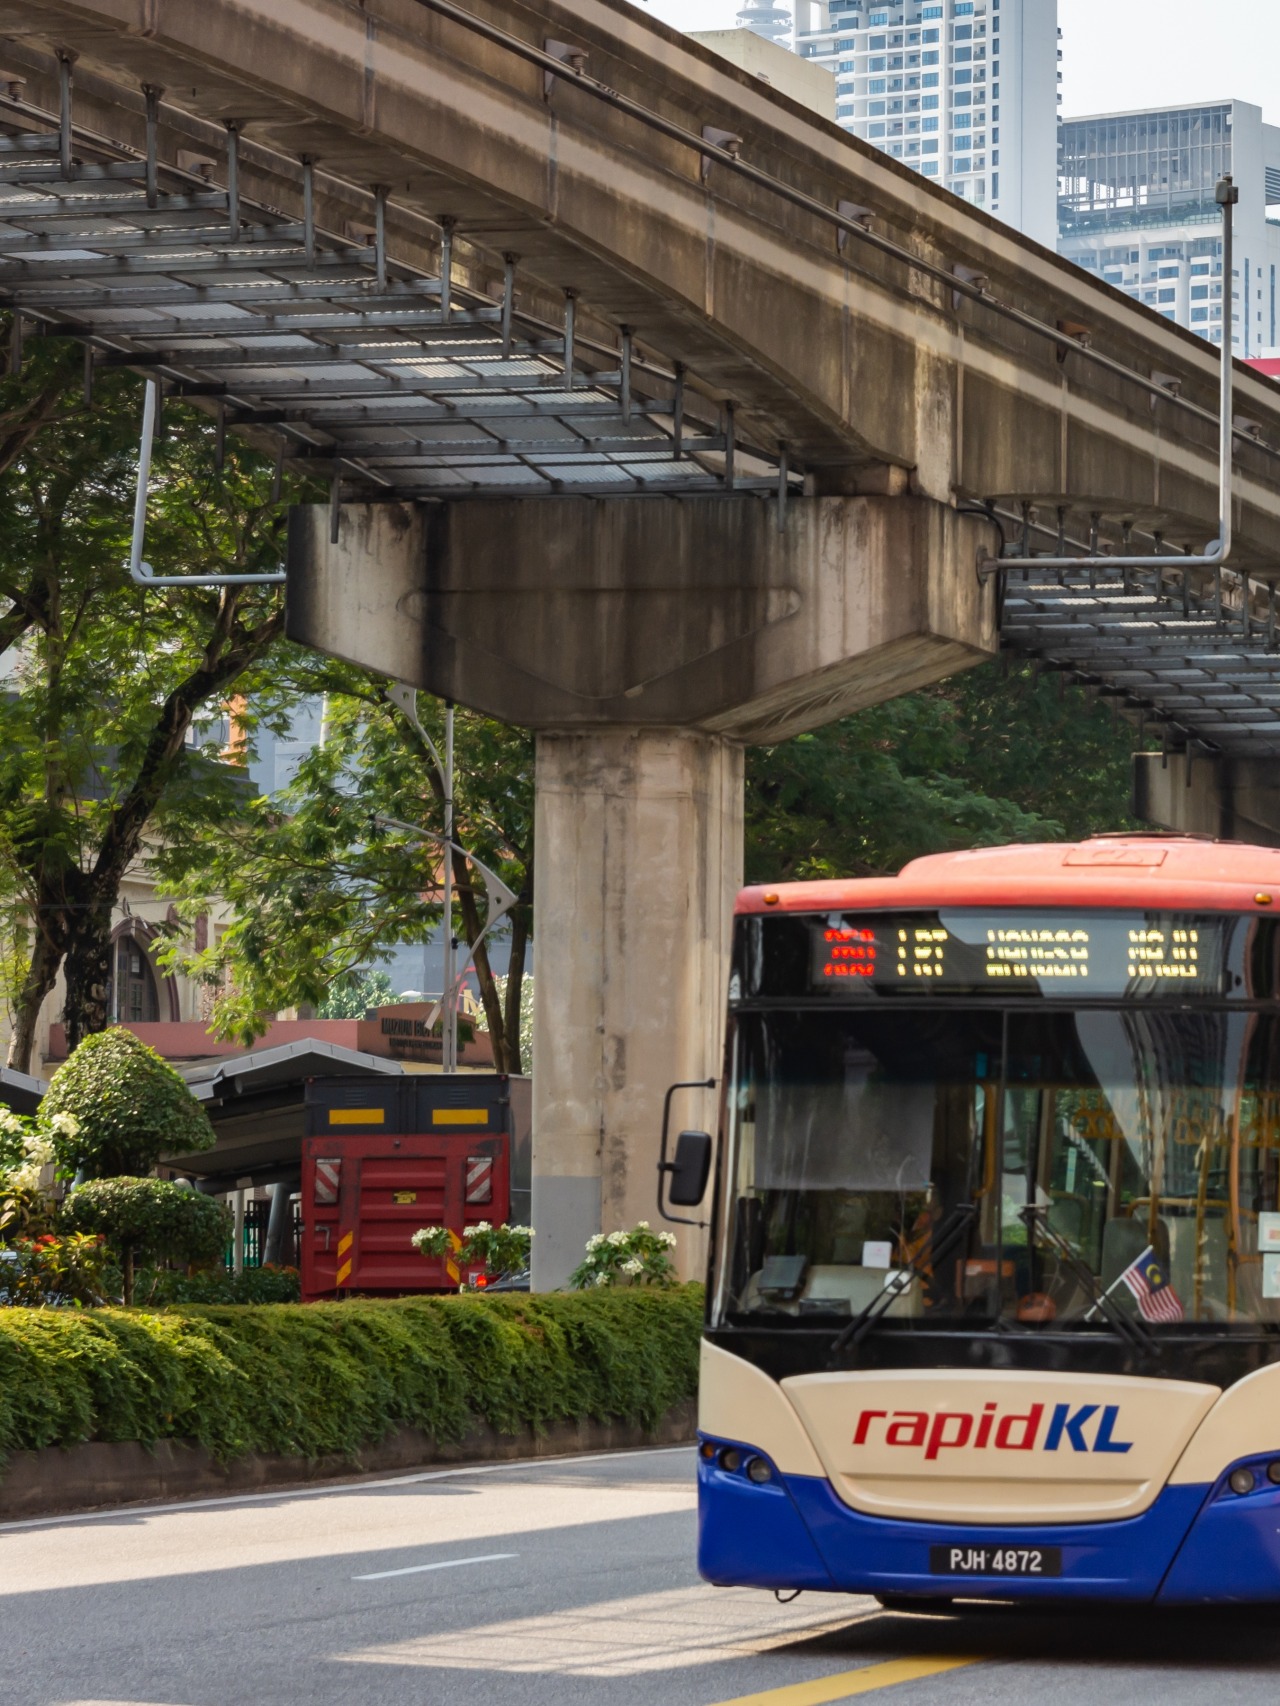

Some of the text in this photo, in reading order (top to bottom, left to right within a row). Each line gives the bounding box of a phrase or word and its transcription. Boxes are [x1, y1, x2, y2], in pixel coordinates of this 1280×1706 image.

[852, 1401, 1134, 1460] rapidKL
[950, 1548, 1042, 1572] PJH 4872
